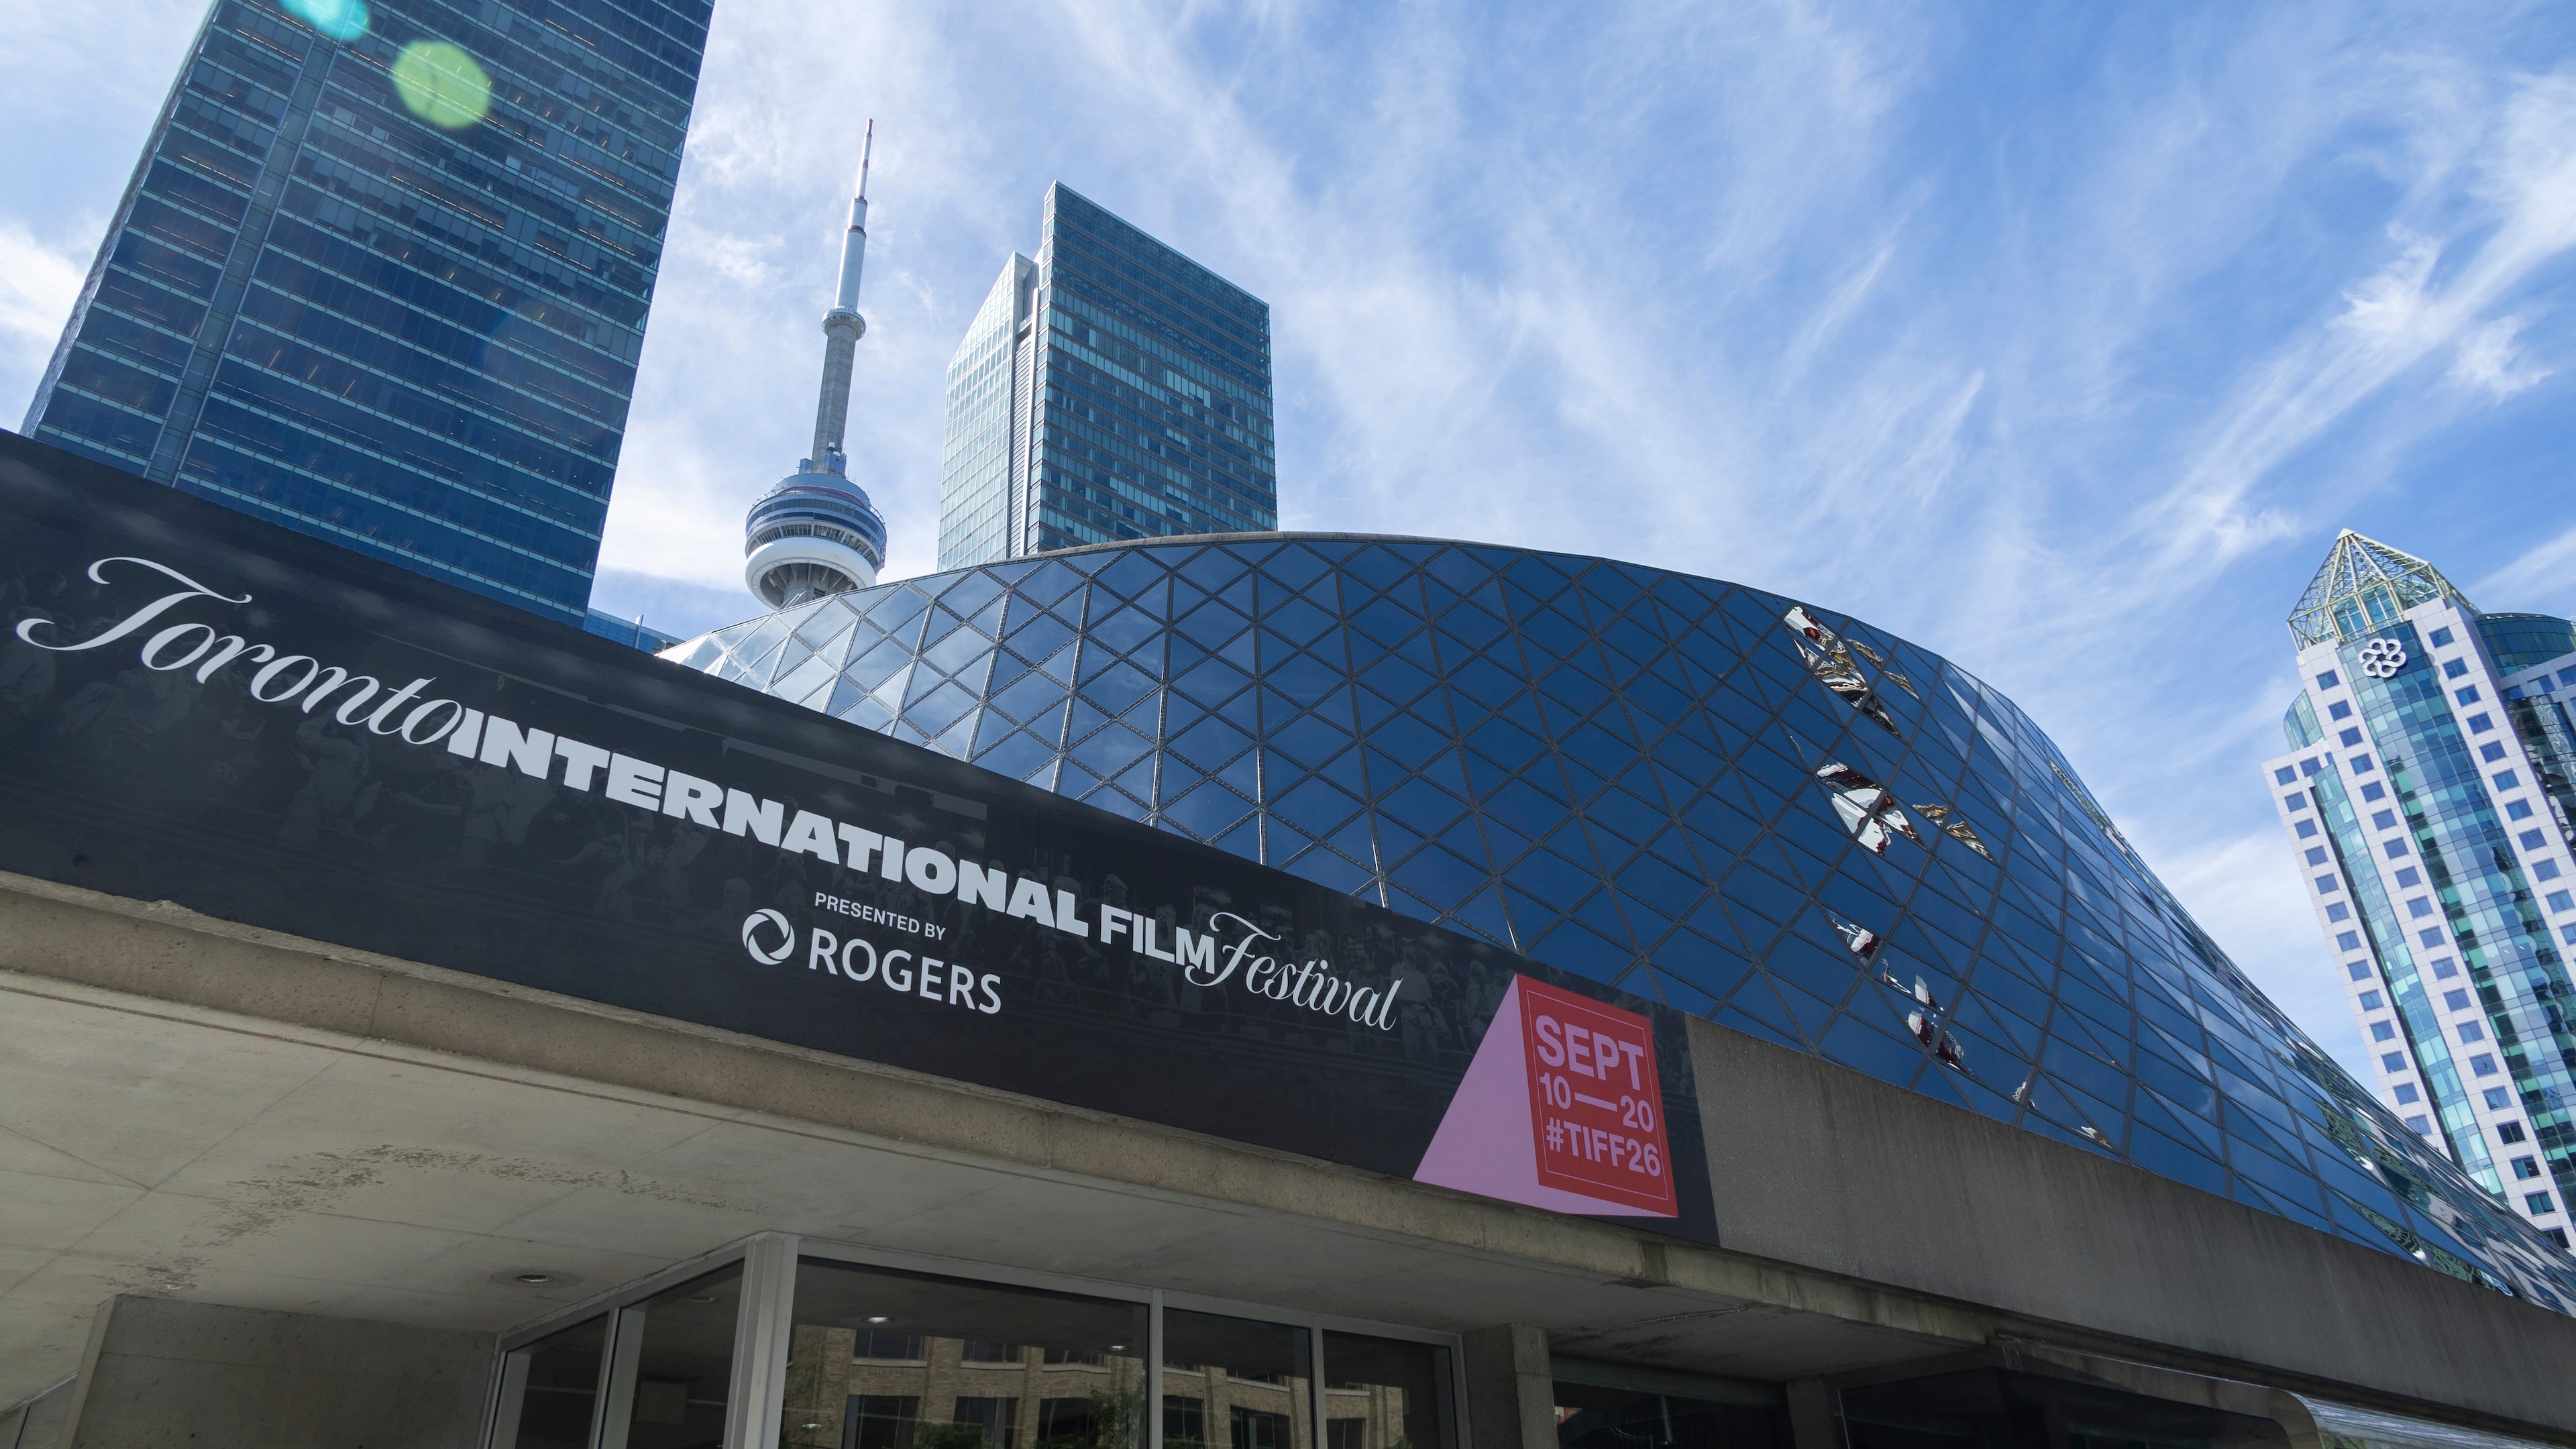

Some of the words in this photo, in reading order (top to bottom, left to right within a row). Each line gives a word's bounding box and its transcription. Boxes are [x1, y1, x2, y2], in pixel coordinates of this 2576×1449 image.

[16, 557, 465, 745] Toronto
[447, 707, 1089, 937] INTERNATIONAL
[1100, 903, 1216, 975] FILM
[1184, 912, 1403, 1031] Festival
[814, 892, 920, 934] PRESENTED
[924, 922, 946, 941] BY
[808, 927, 1002, 1014] ROGERS
[1536, 1014, 1644, 1091] SEPT
[1546, 1116, 1661, 1177] #TIFF26
